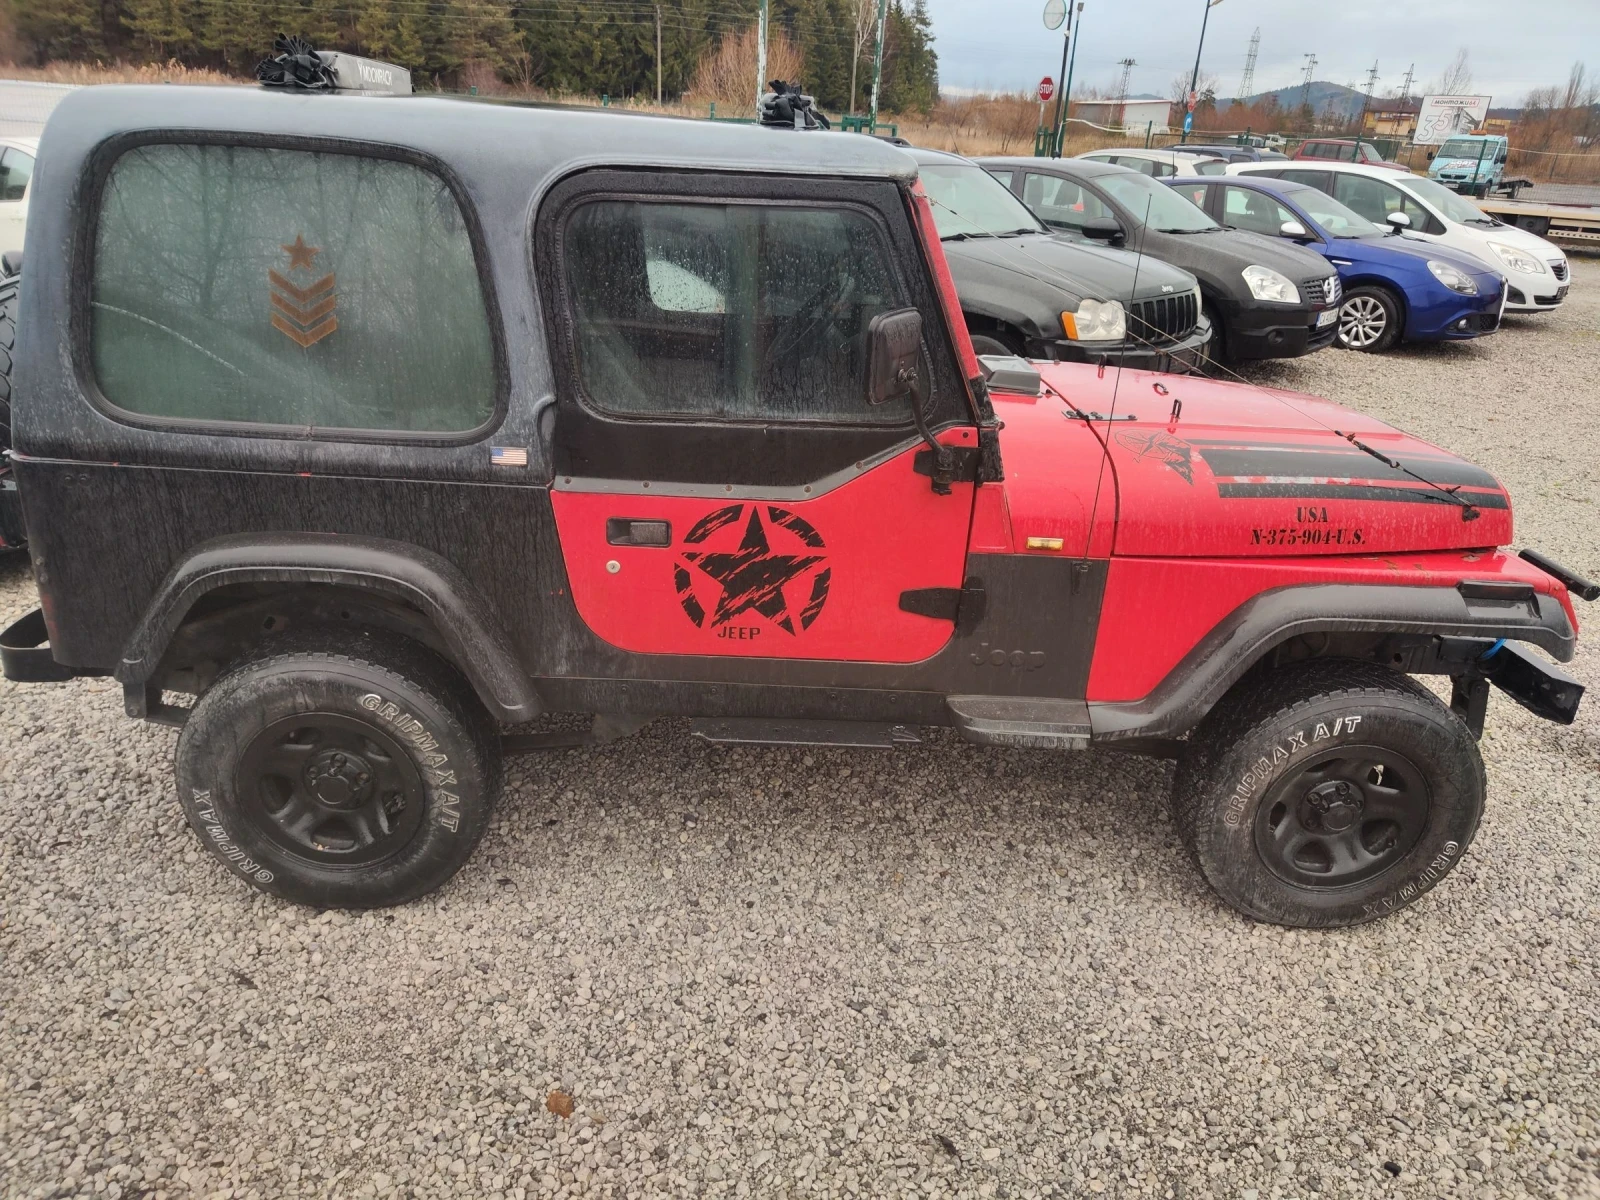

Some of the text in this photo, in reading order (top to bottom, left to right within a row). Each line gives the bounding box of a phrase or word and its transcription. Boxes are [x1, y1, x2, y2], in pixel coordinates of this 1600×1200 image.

[1040, 84, 1053, 94] STOP
[1416, 108, 1453, 142] 35
[1296, 506, 1329, 523] USA
[1250, 528, 1367, 546] N-375-904-U.S.
[717, 624, 761, 641] JEEP
[970, 642, 1047, 672] Jeep
[360, 693, 457, 786] GRIPMAX
[1223, 716, 1361, 828] GRIPMAX A/T
[192, 788, 274, 884] GRIPMAX
[1361, 840, 1460, 918] GRIPMAX
